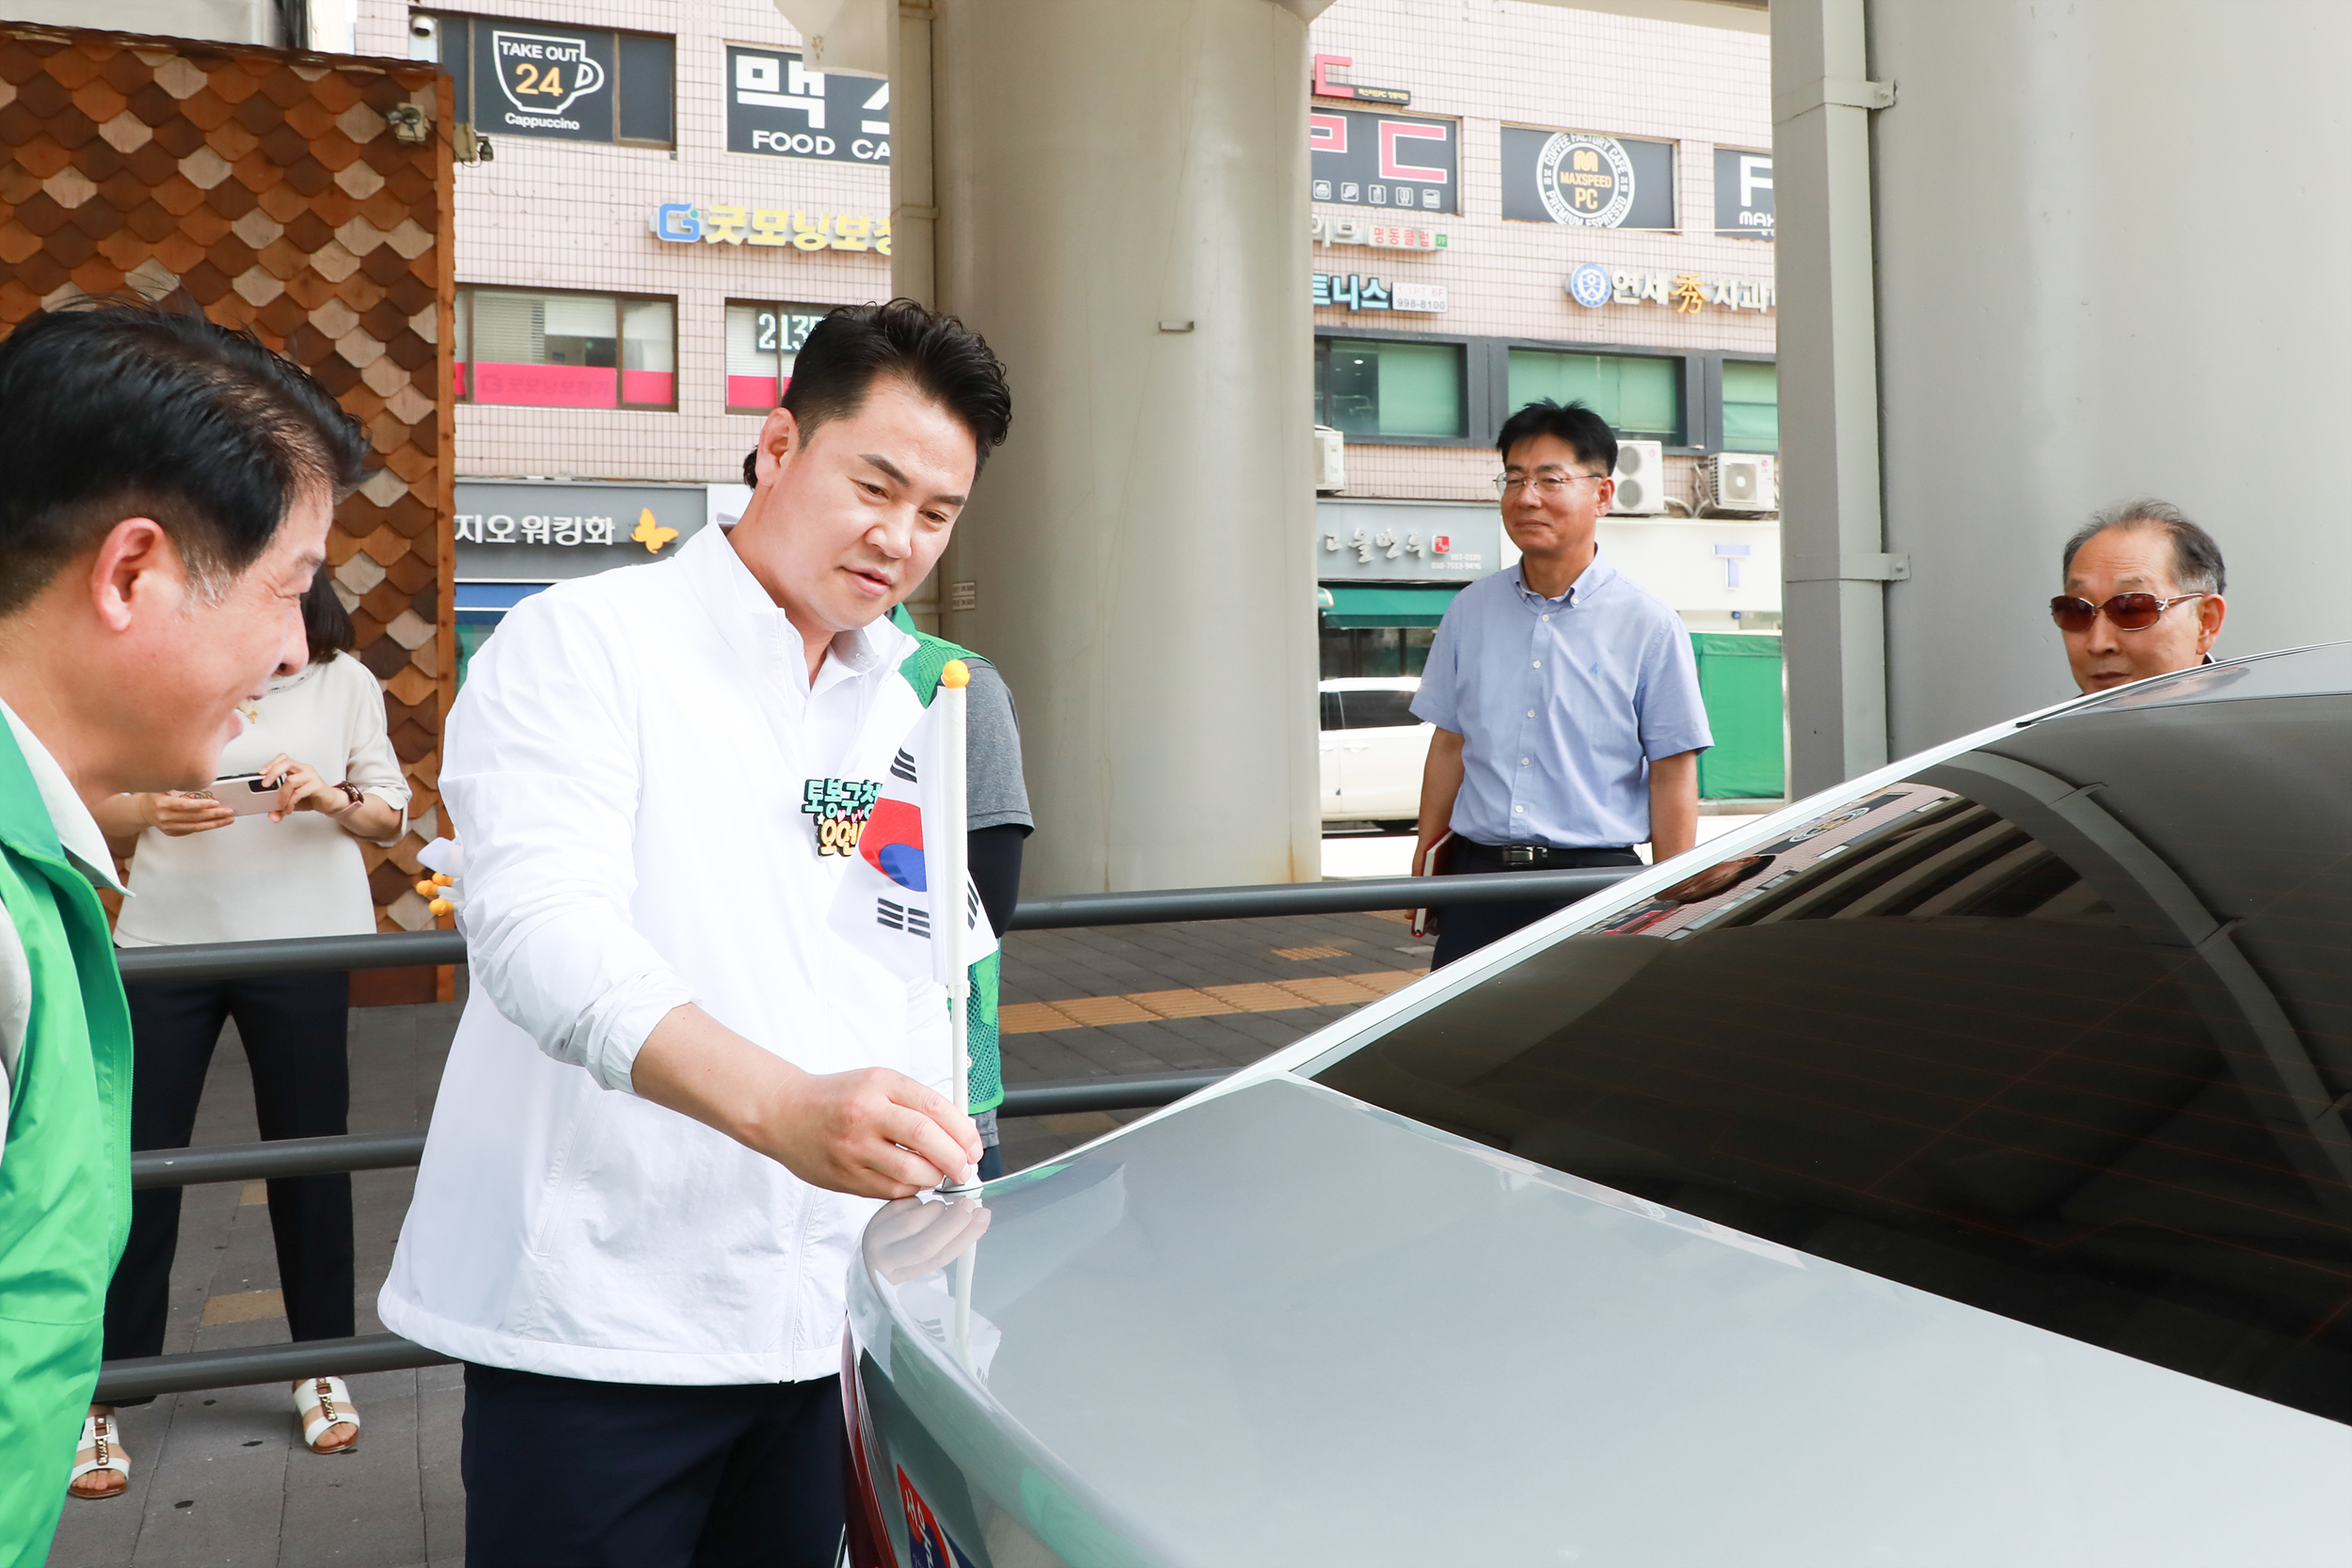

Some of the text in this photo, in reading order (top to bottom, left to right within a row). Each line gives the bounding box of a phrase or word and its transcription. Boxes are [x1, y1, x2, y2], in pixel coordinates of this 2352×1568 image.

[500, 41, 580, 62] TAKE OUT
[516, 63, 564, 97] 24
[505, 113, 580, 130] Cappuccino
[753, 130, 835, 155] FOOD
[1544, 134, 1571, 166] COFFEE
[1609, 148, 1628, 174] CAFE
[1560, 171, 1613, 188] MAXSPEED
[1546, 190, 1627, 228] PREMIUM ESPRESSO
[1575, 187, 1598, 210] PC
[1397, 298, 1445, 309] 998-8100
[818, 818, 866, 857] 오언
